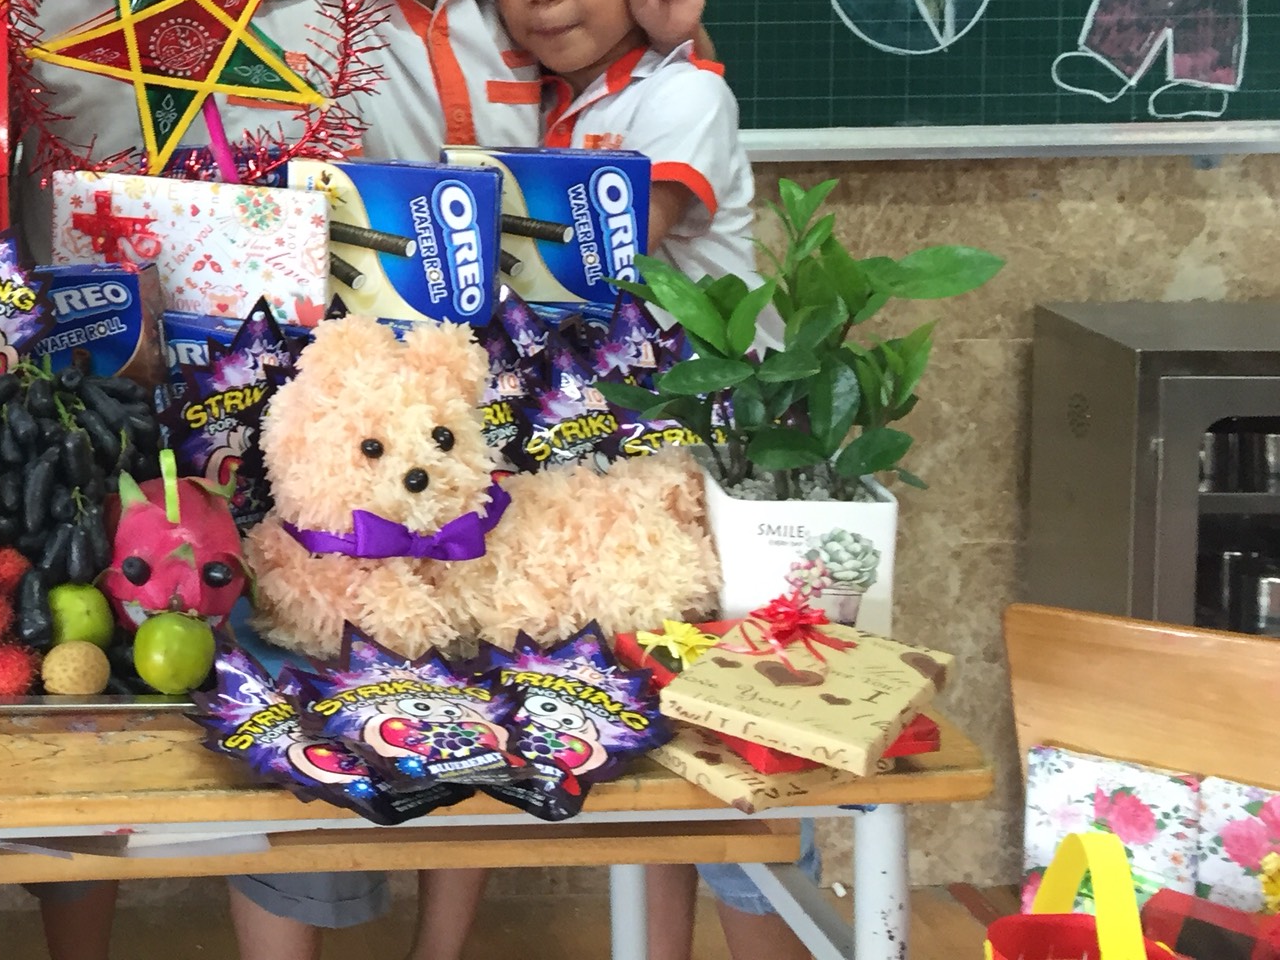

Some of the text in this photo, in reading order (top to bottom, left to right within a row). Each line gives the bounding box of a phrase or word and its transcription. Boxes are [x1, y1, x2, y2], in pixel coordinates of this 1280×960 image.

[568, 183, 596, 244] WAFER
[410, 195, 448, 304] WAFER ROLL
[440, 186, 482, 312] OREO
[580, 242, 604, 287] ROLL
[51, 282, 129, 318] REO
[33, 316, 129, 357] WAFER ROLL
[757, 523, 806, 539] SMILE
[313, 680, 493, 717] STRIKING
